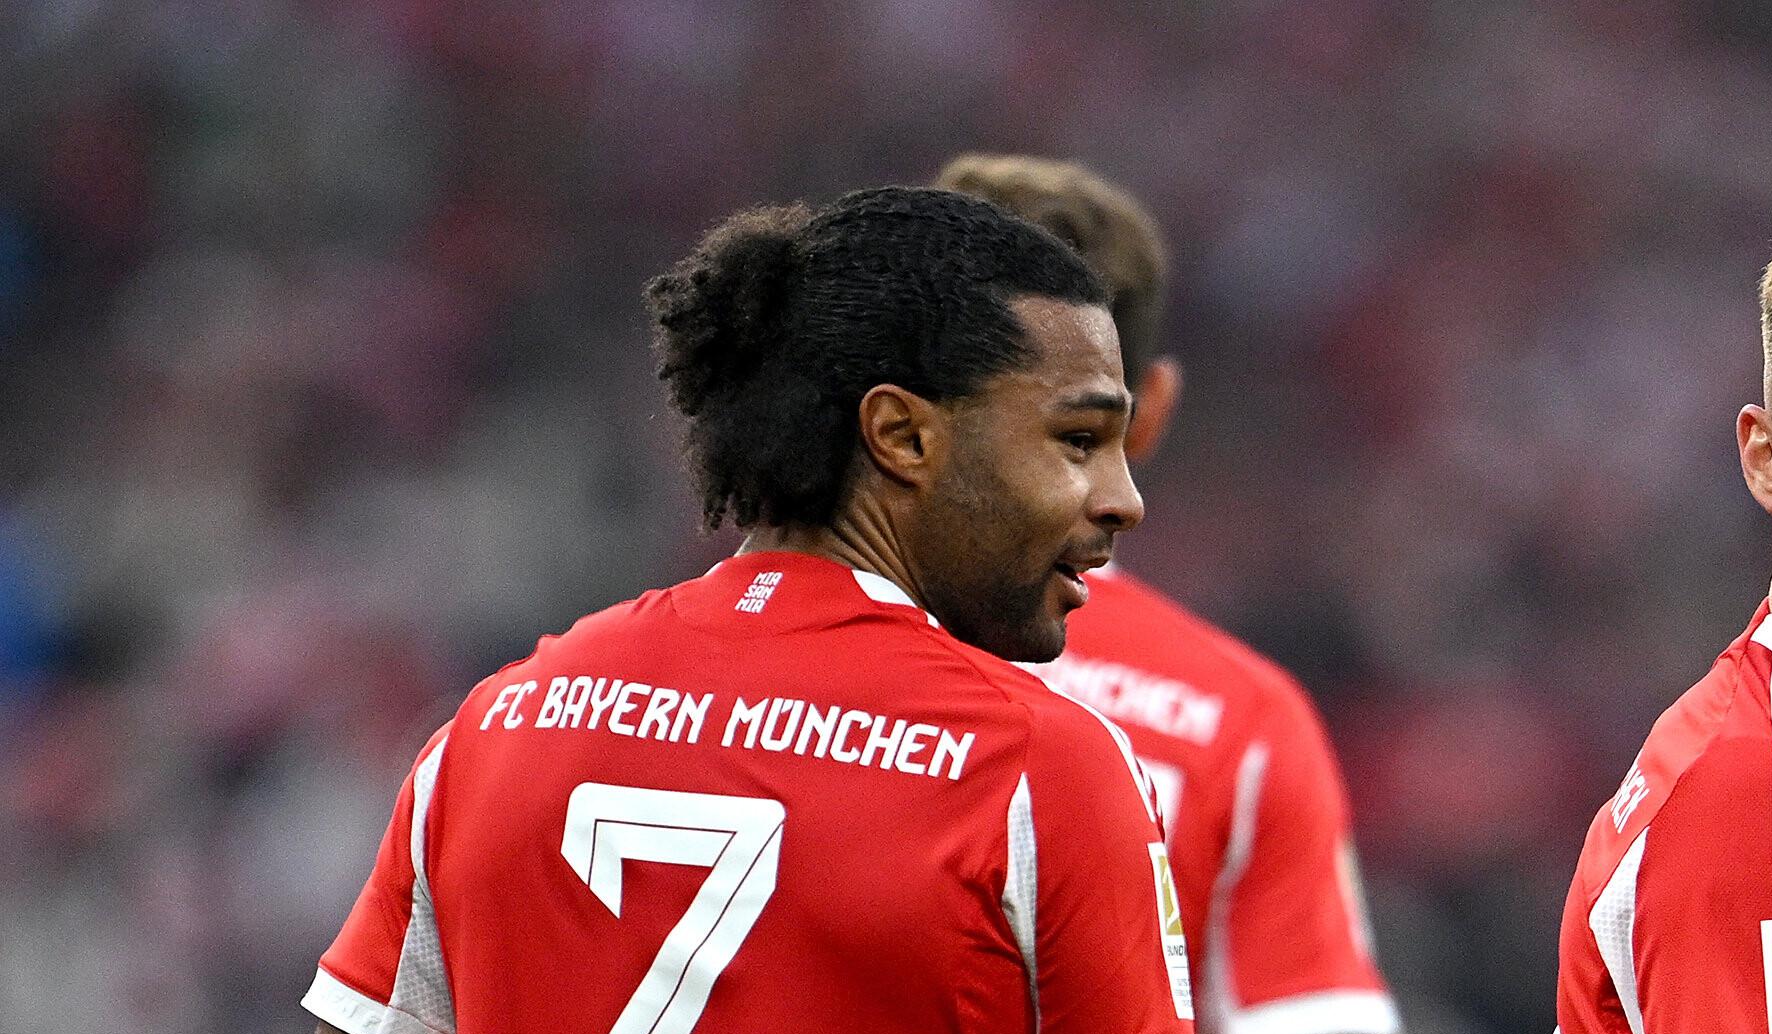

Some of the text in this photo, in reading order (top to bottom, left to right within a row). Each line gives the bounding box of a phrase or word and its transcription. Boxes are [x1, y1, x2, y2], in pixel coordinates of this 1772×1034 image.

[753, 571, 783, 586] MIA
[744, 584, 775, 599] SAN
[734, 597, 766, 614] MIA
[480, 676, 976, 781] FC BAYERN MÜNCHEN
